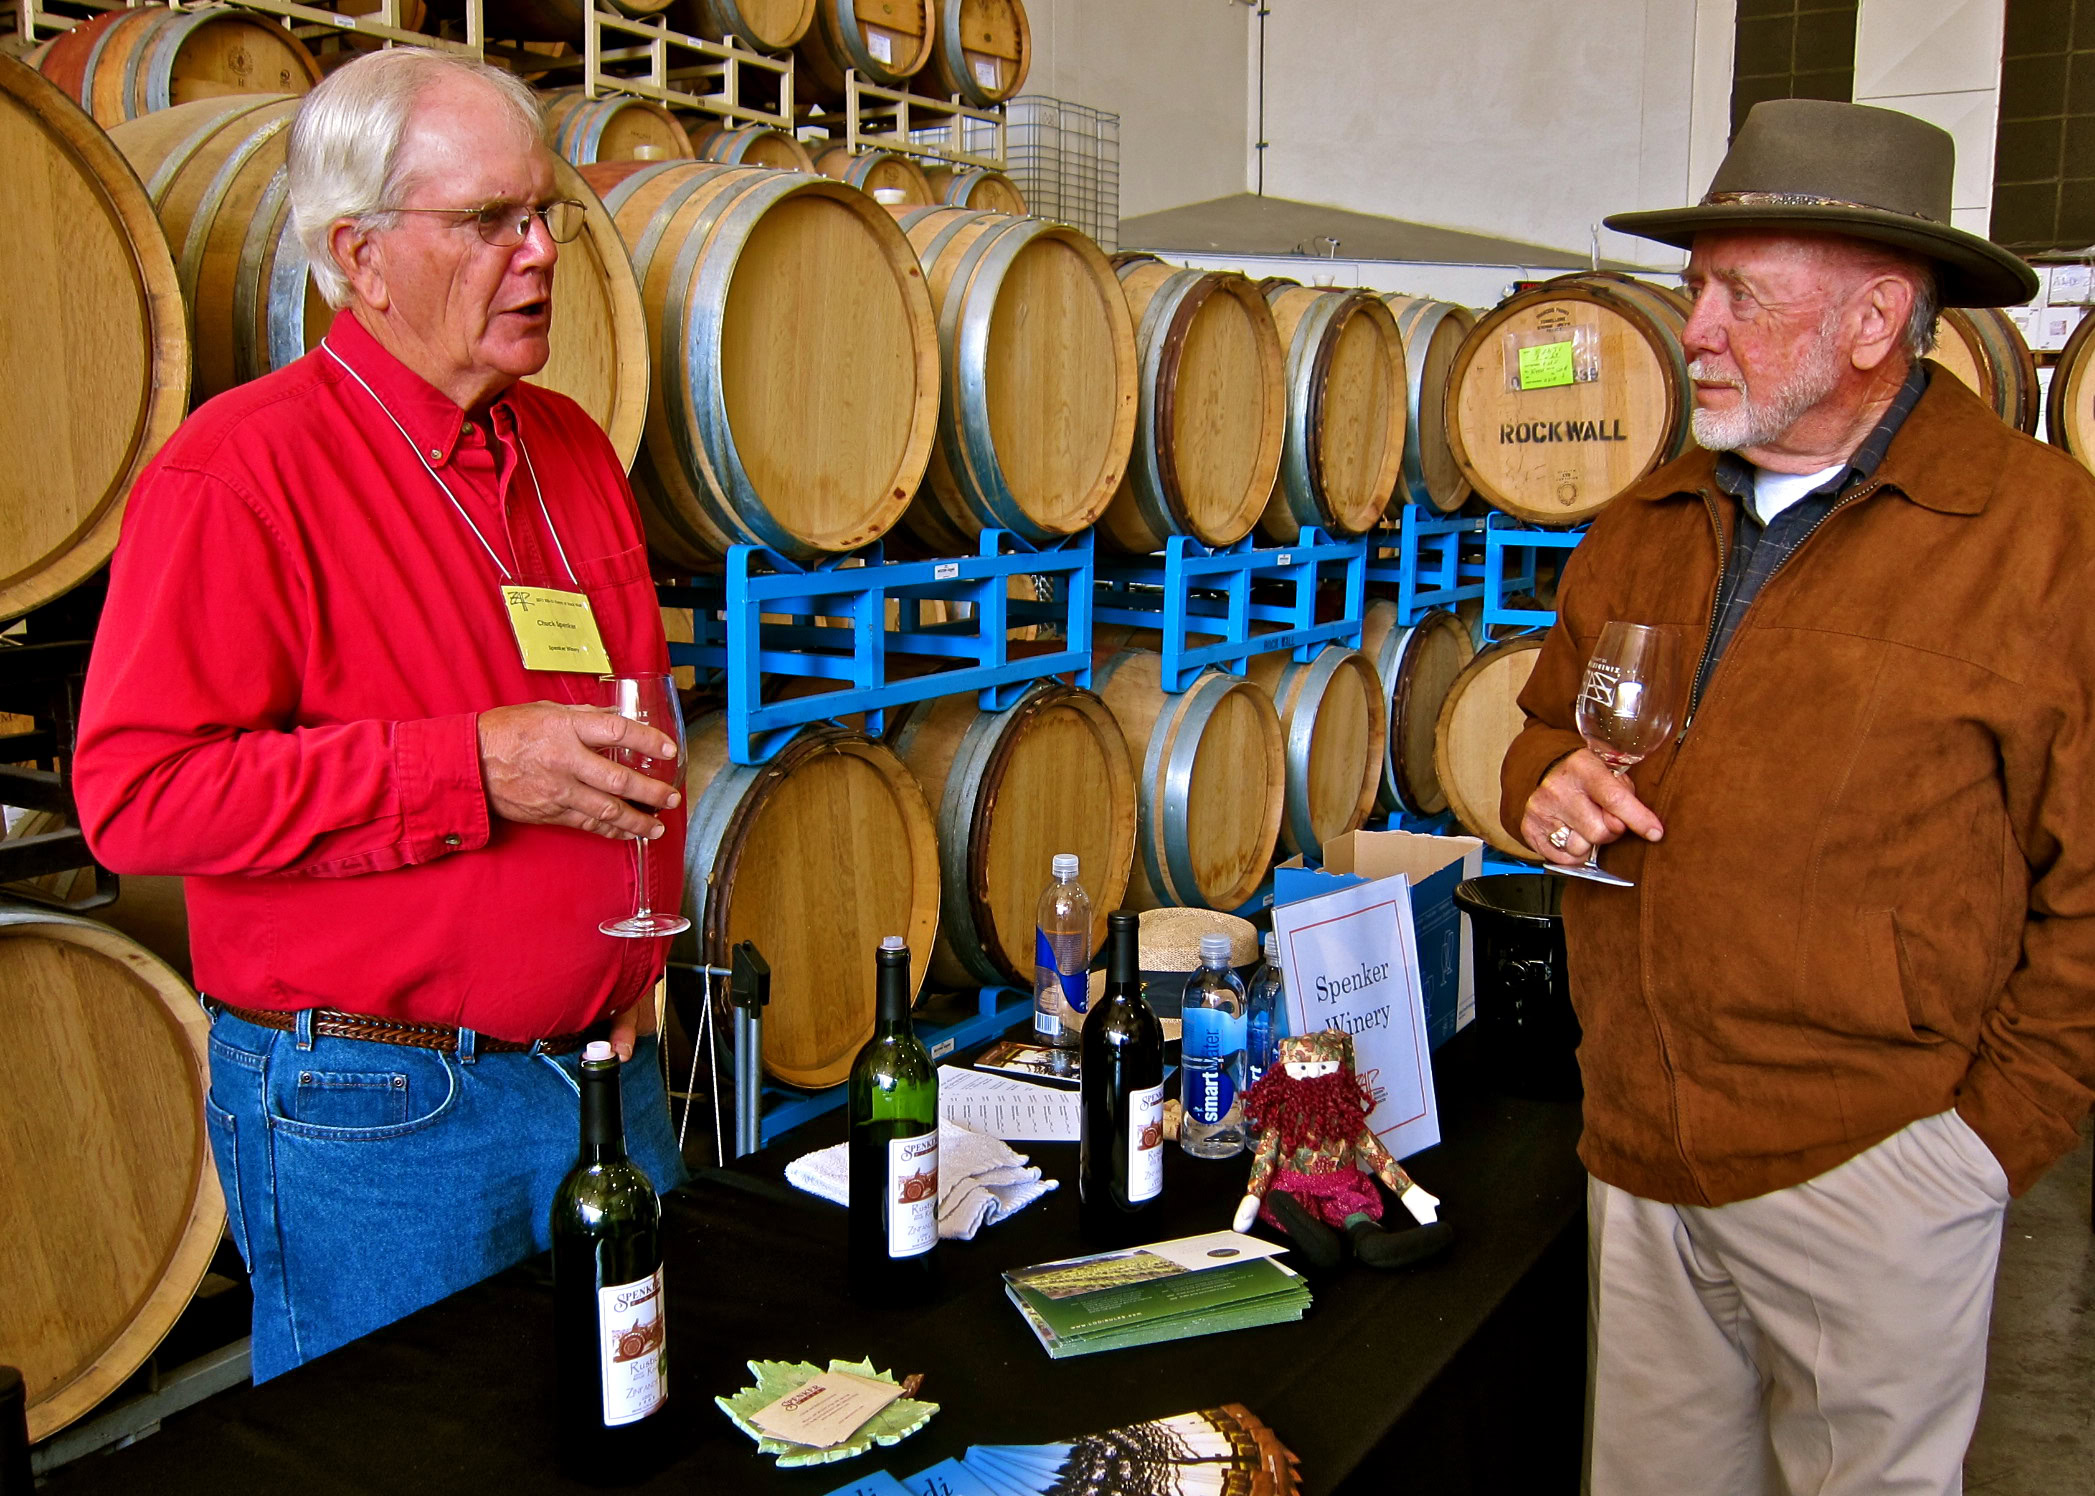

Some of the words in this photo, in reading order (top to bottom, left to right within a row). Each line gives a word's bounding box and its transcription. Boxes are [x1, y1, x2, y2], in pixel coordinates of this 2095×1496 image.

[536, 619, 556, 628] Chuck
[556, 619, 577, 630] Spenker
[1314, 961, 1390, 1005] Spenker
[1324, 1005, 1391, 1036] Winery
